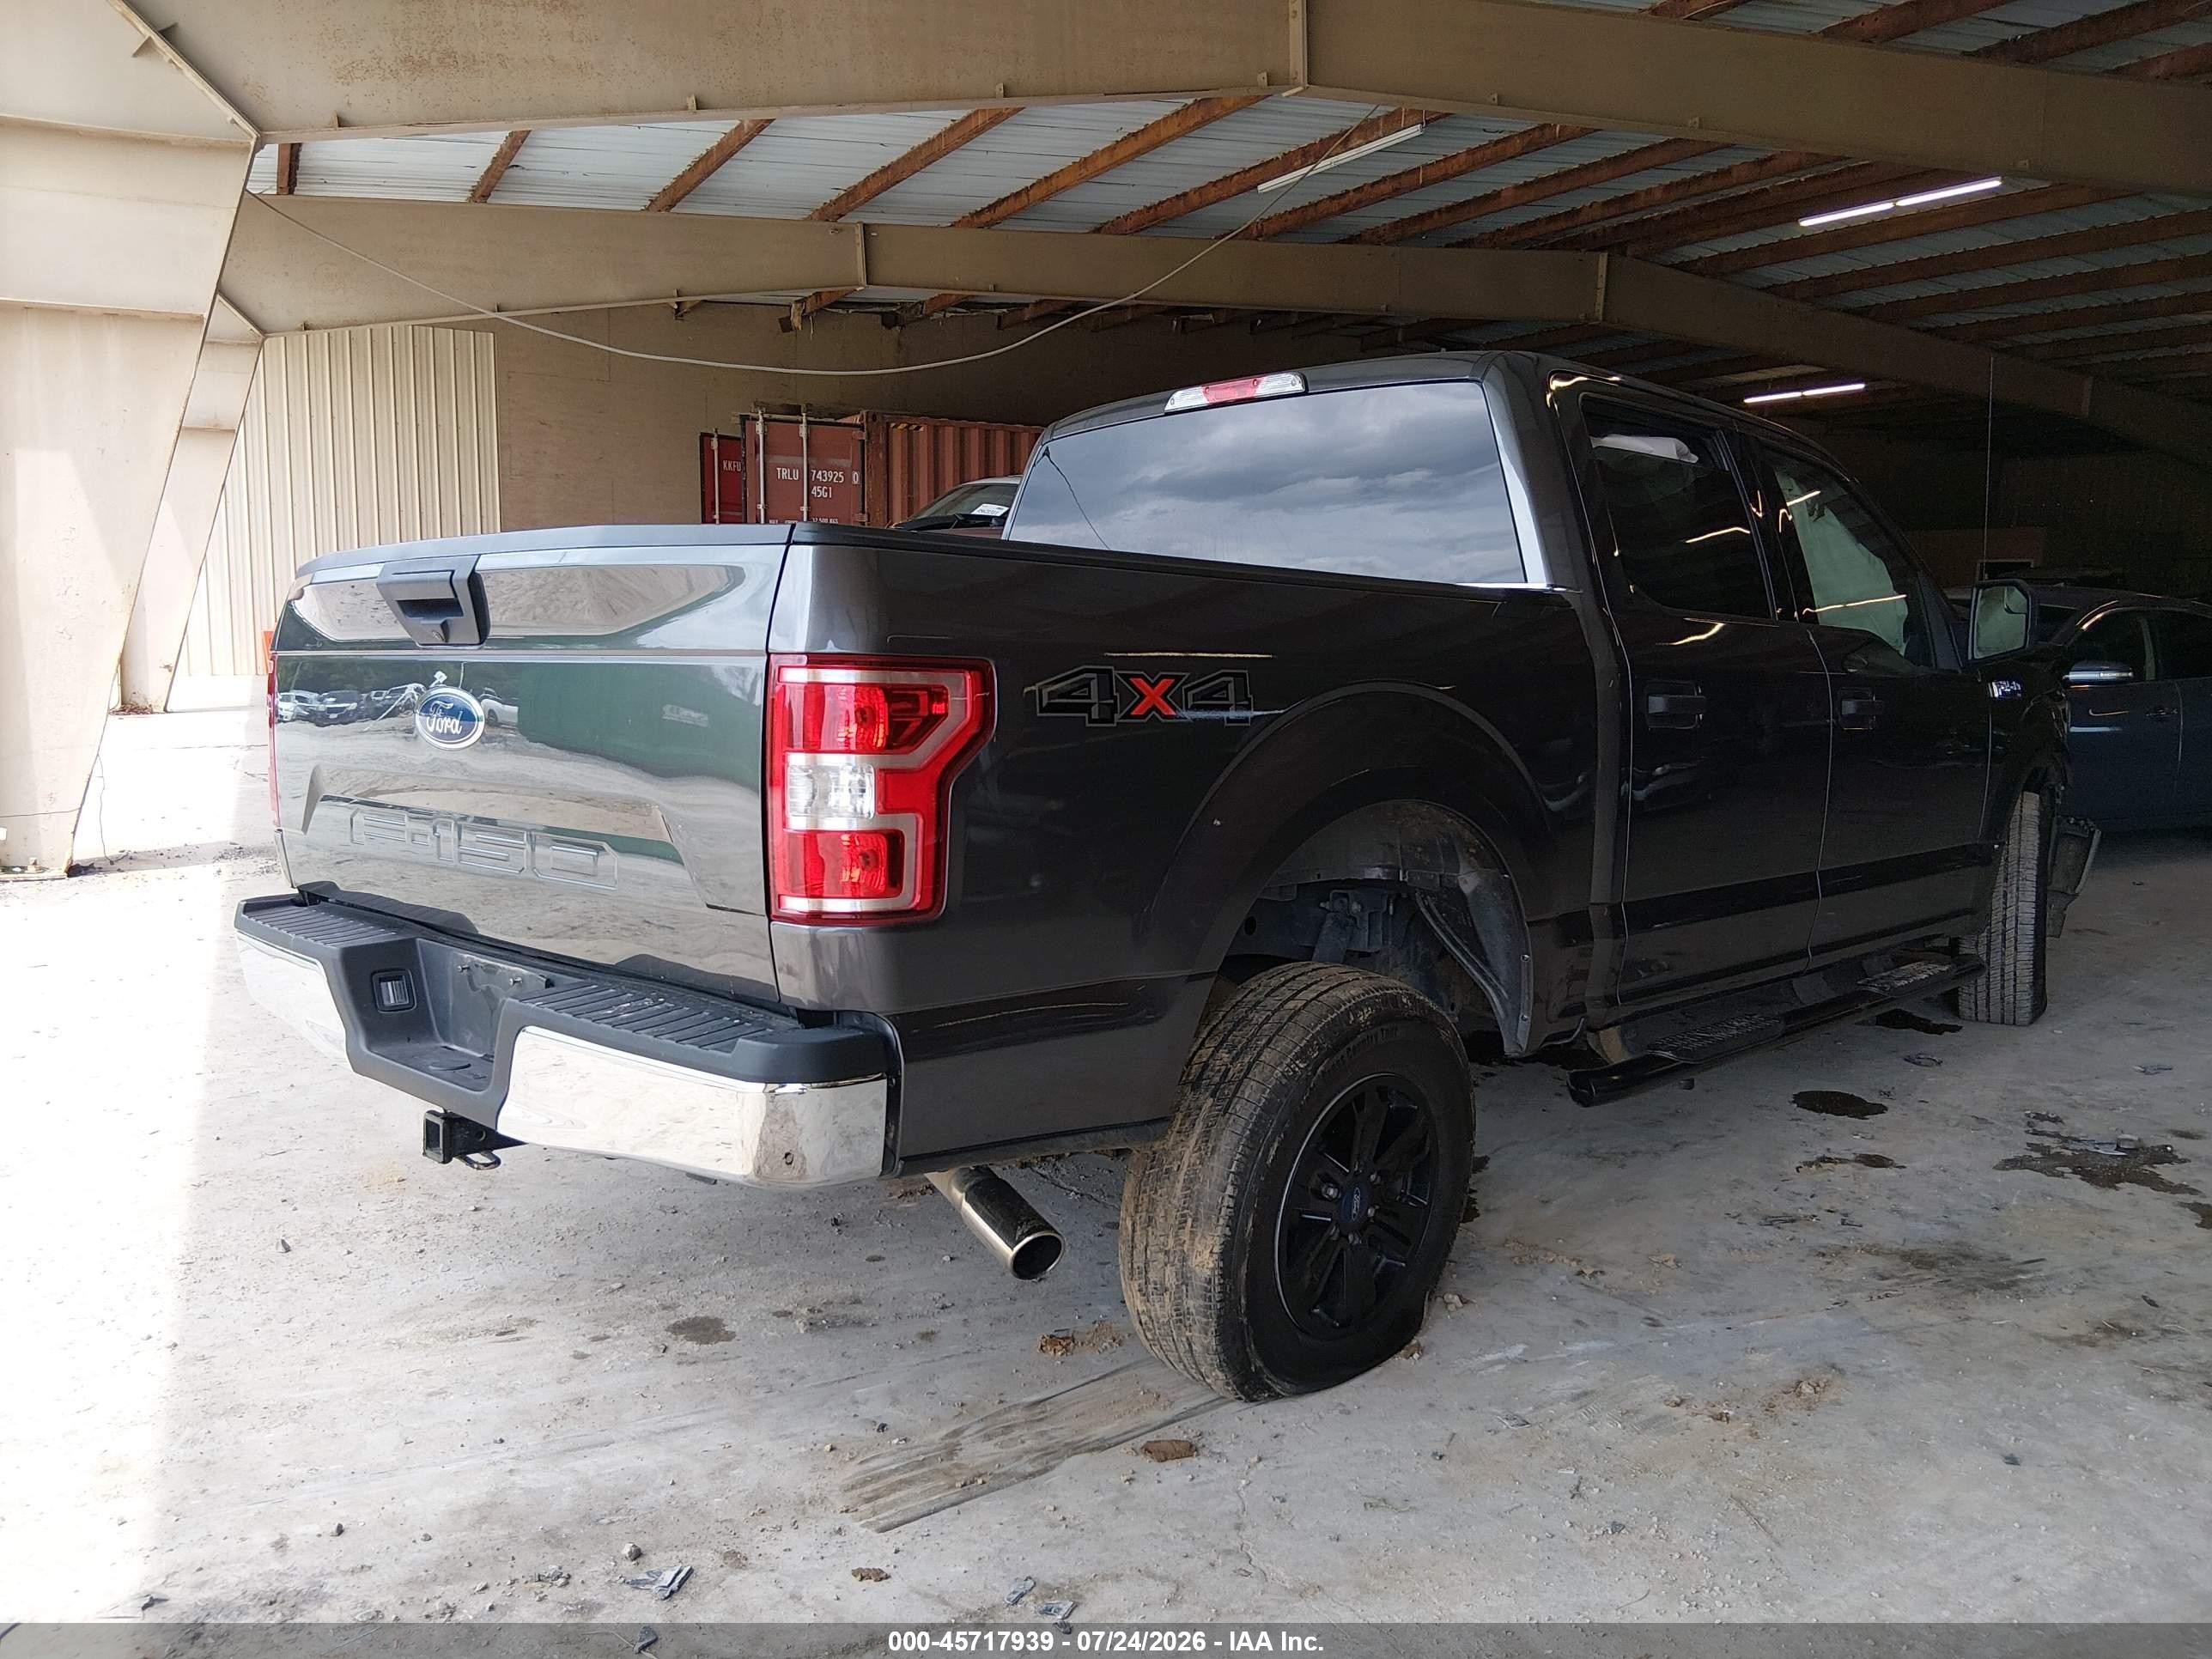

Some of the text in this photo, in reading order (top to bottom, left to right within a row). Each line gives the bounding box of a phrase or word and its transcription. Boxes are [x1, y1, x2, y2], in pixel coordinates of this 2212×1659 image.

[723, 459, 742, 471] KKFU
[776, 467, 860, 484] TRLU 743925 0
[811, 485, 832, 498] 45G1
[1036, 665, 1254, 726] 4X4
[426, 700, 463, 735] Ford
[349, 807, 619, 890] F-150
